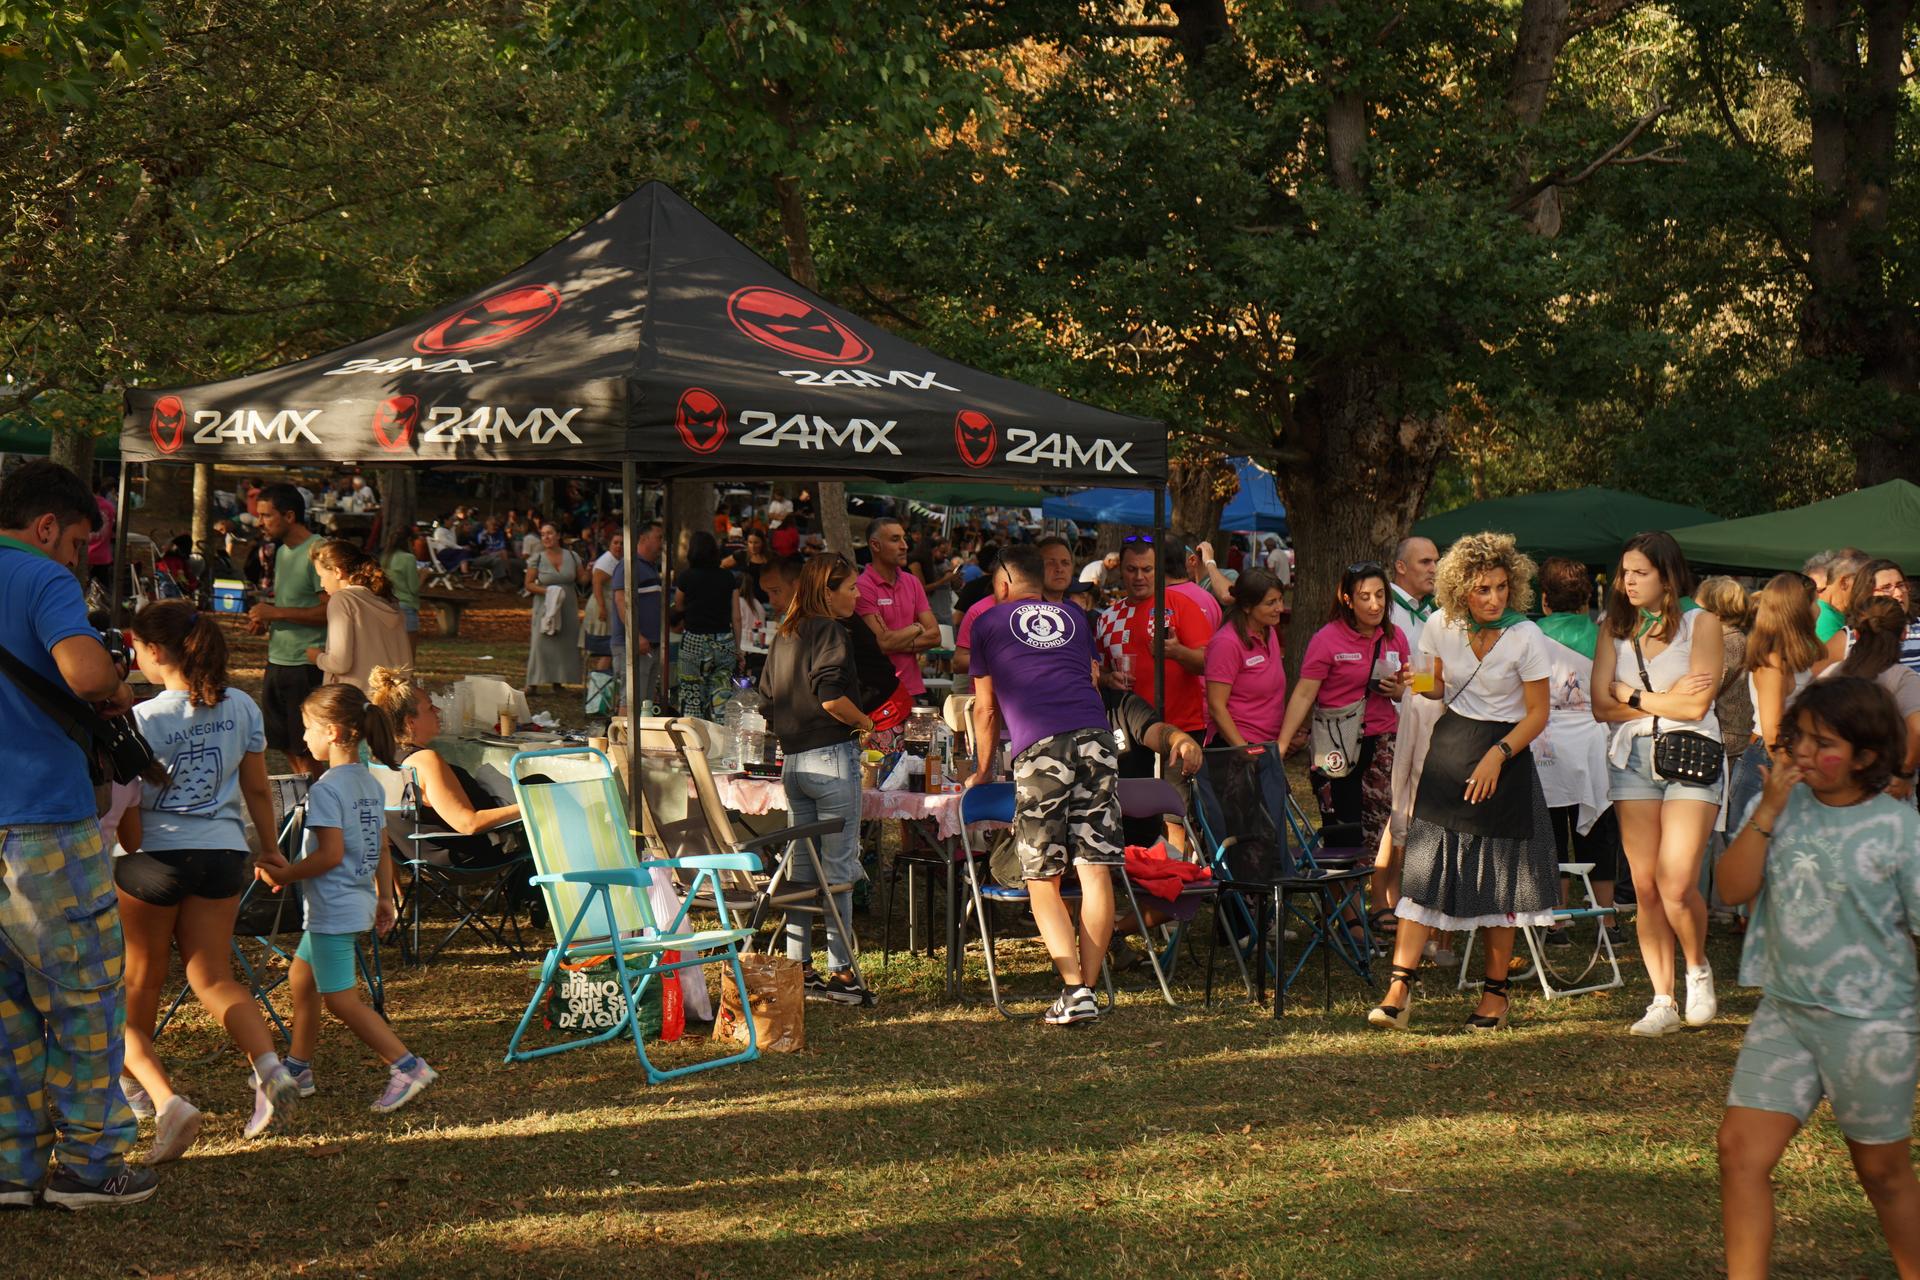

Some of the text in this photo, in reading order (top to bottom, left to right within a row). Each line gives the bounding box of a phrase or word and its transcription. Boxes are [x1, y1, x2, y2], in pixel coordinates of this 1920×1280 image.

[323, 357, 497, 376] 24MX
[778, 369, 962, 392] 24MX
[193, 409, 323, 445] 24MX
[423, 406, 583, 445] 24MX
[739, 410, 902, 456] 24MX
[1006, 428, 1138, 474] 24MX
[1016, 604, 1061, 616] KOMANDO
[1026, 637, 1066, 648] ROTONDA
[561, 980, 619, 999] BUENO
[568, 998, 604, 1014] QUE
[559, 1012, 579, 1028] DE
